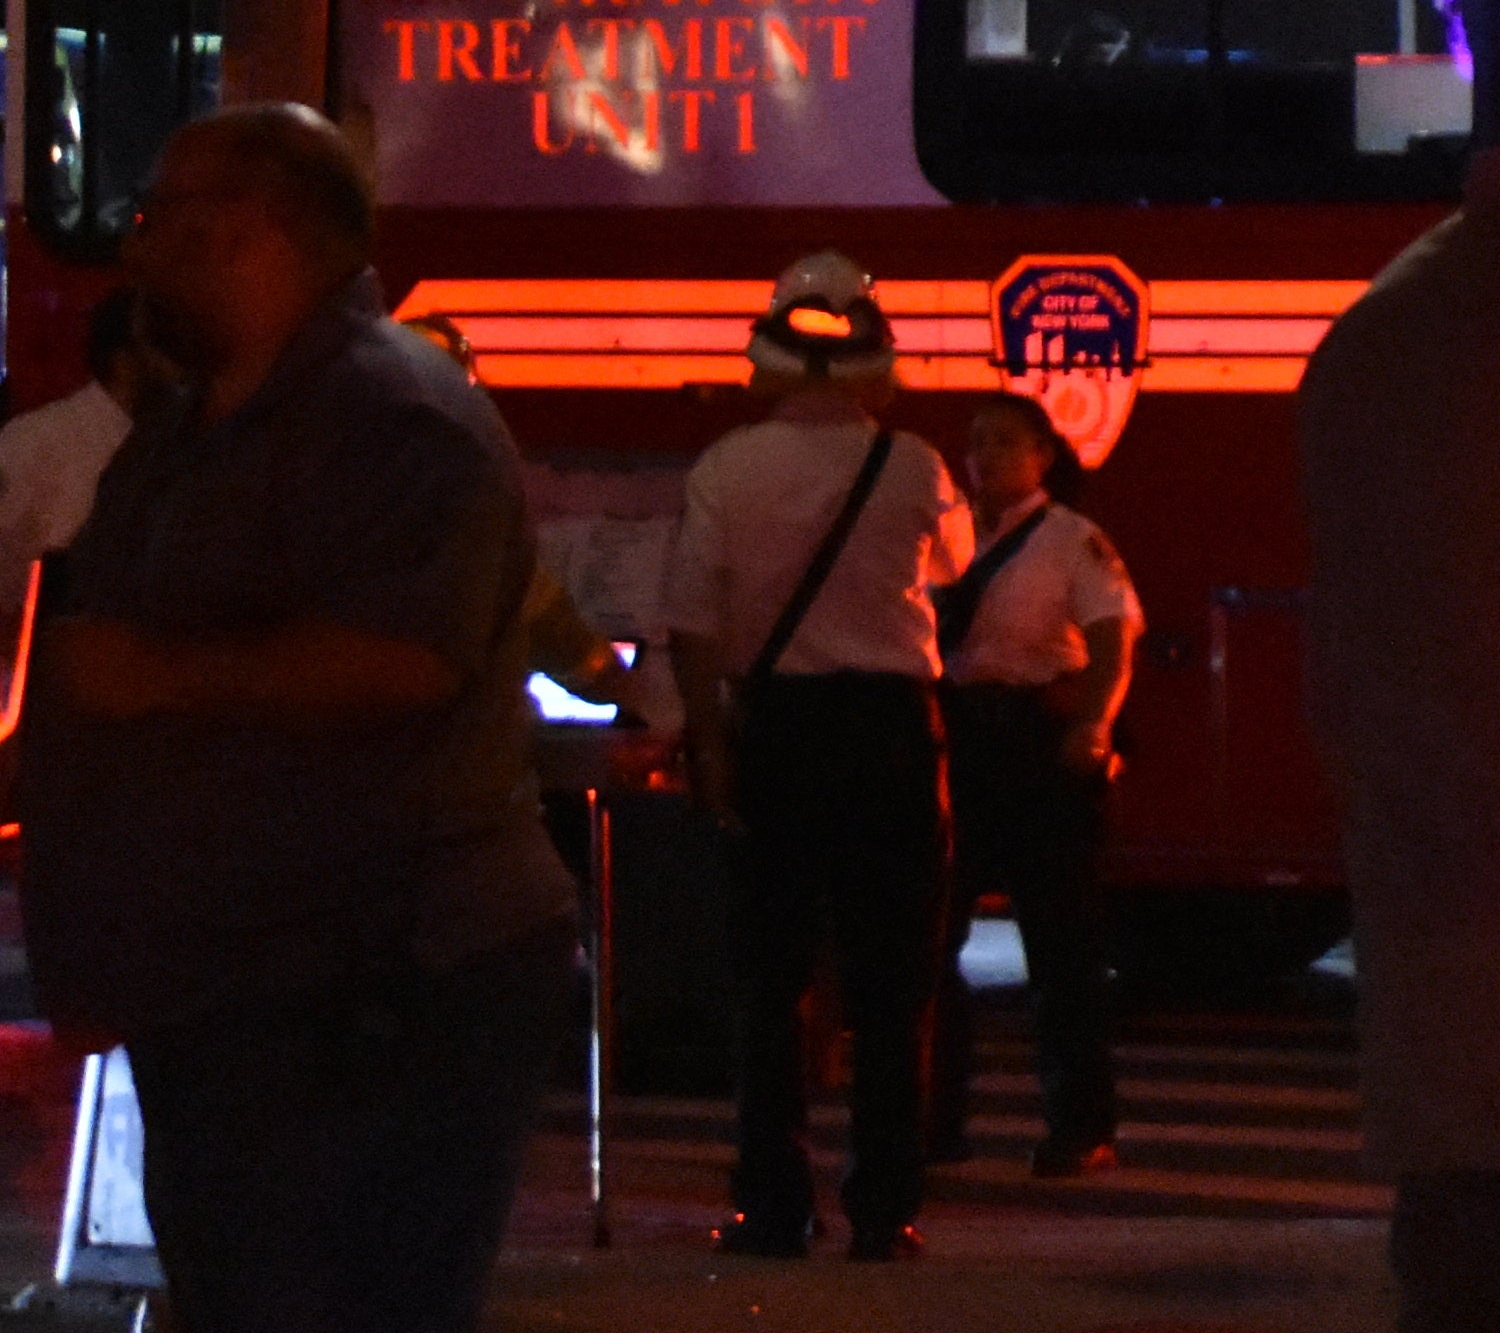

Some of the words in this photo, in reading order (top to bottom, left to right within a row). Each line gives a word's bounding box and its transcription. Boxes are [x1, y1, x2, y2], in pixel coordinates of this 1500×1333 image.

[383, 13, 867, 82] TREATMENT
[529, 89, 718, 157] UNIT
[1030, 314, 1067, 329] NEW
[1068, 314, 1111, 330] YORK
[1042, 294, 1077, 313] CITY
[1078, 294, 1100, 312] OF
